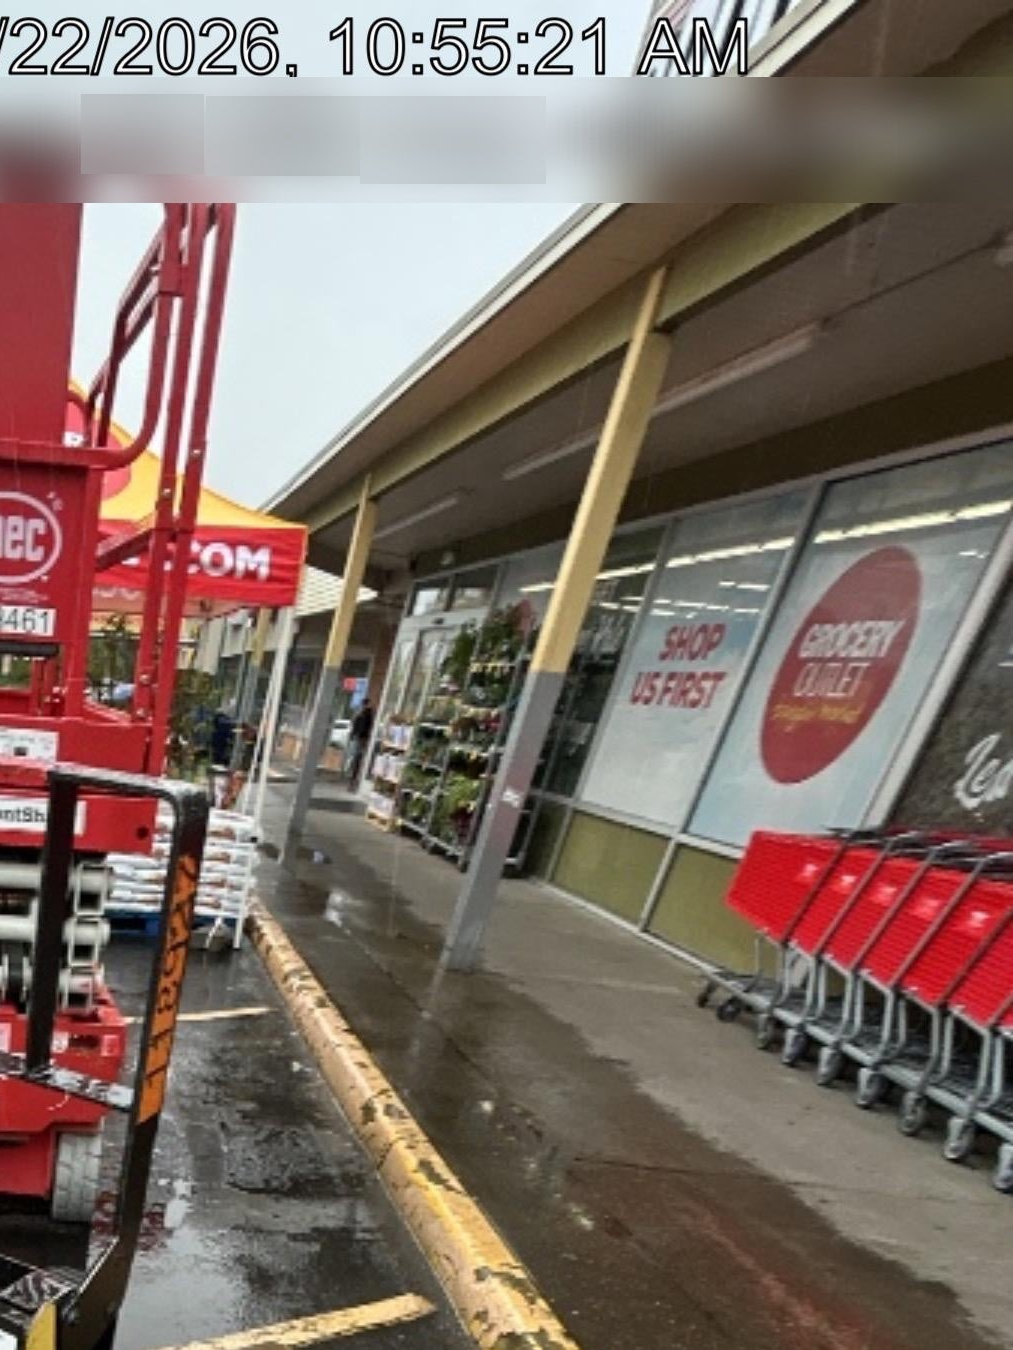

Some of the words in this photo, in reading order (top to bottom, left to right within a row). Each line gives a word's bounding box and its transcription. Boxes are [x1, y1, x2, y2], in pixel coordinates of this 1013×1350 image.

[659, 622, 727, 661] SHOP
[798, 619, 905, 658] GROCERY
[631, 671, 658, 705] US
[657, 670, 728, 709] FIRST
[793, 662, 870, 697] OUTLET
